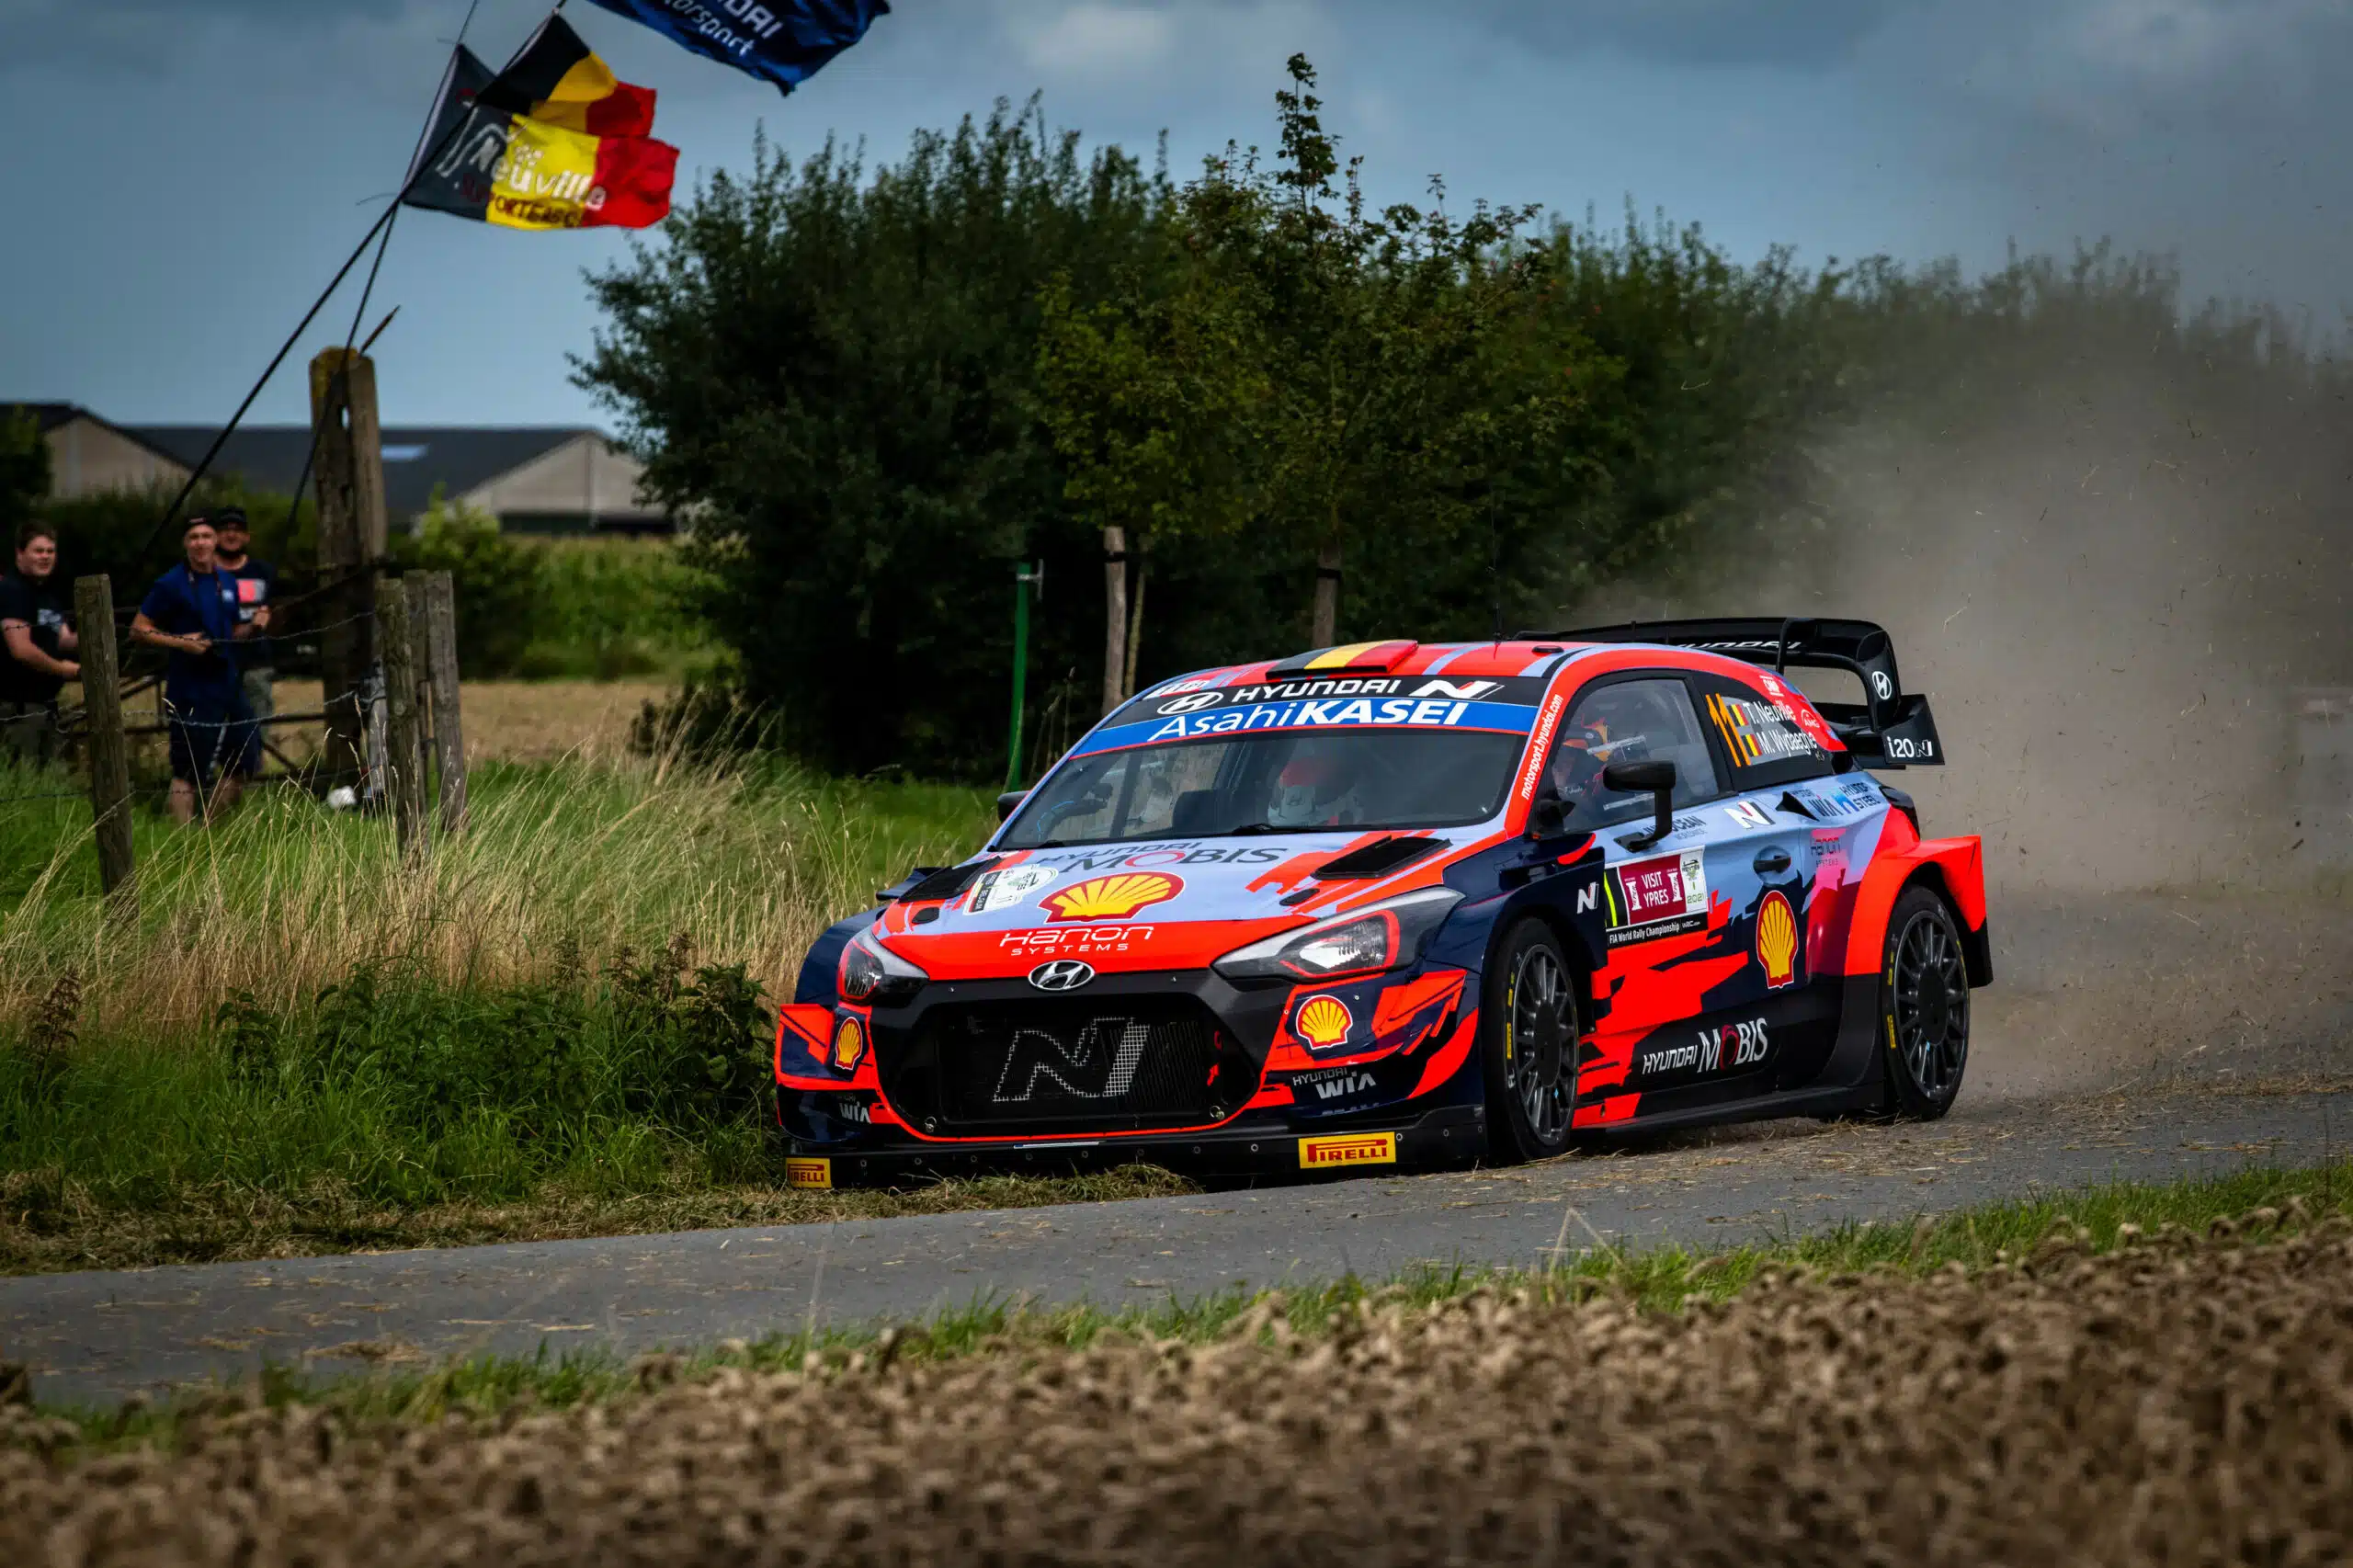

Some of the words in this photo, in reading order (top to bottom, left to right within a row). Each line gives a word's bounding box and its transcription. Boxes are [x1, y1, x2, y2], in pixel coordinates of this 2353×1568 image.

[1232, 679, 1402, 703] HYUNDAI
[1521, 694, 1563, 800] motorsport.hyundai.com
[1036, 842, 1202, 864] HYUNDAI
[1059, 847, 1289, 874] MOBIS
[1641, 871, 1662, 889] VISIT
[1643, 889, 1669, 908] YPRES
[1609, 934, 1618, 944] FIA
[1618, 930, 1632, 942] World
[1632, 928, 1645, 940] Rally
[1645, 922, 1680, 937] Championship
[1011, 943, 1129, 956] SYSTEMS
[1643, 1044, 1699, 1074] HYUNDAI
[1697, 1017, 1768, 1074] MOBIS
[1292, 1066, 1347, 1085] HYUNDAI
[1306, 1139, 1388, 1163] PIRELLI
